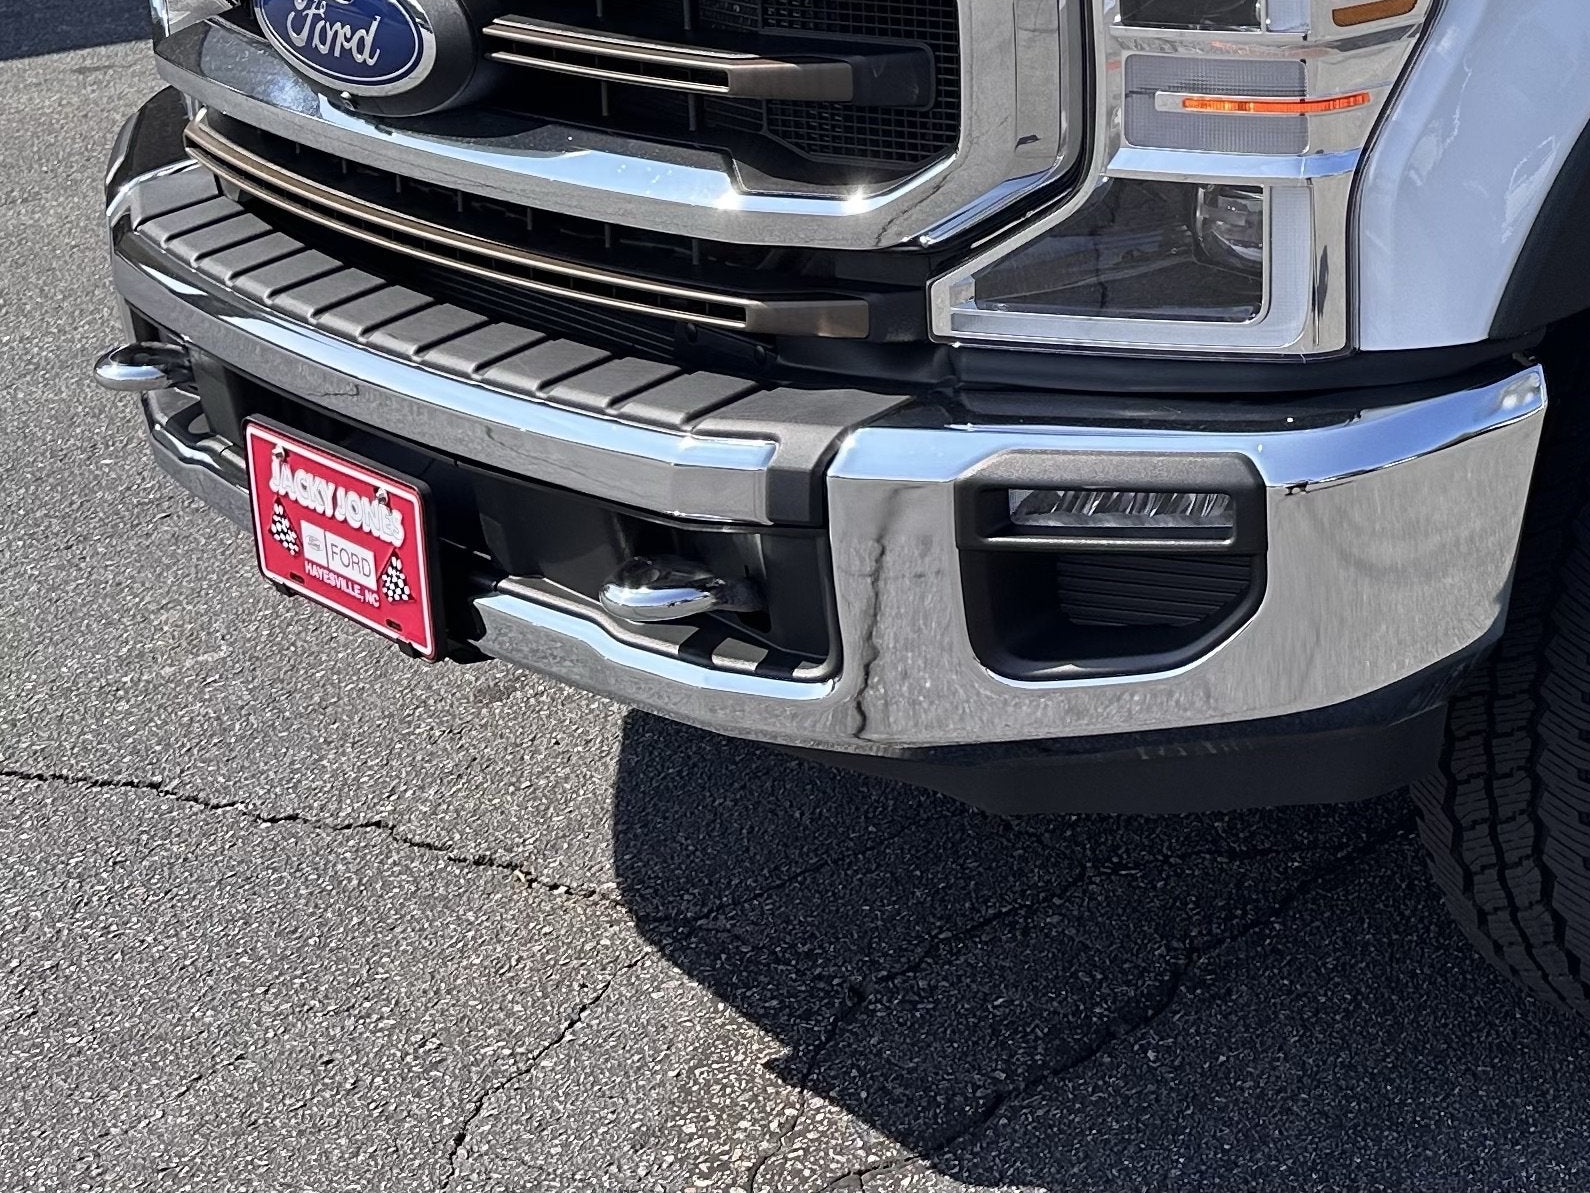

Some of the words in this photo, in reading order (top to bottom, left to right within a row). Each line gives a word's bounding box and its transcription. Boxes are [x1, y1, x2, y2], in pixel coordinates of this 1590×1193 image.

[268, 460, 336, 518] JACKY
[334, 484, 406, 548] JONES
[330, 541, 372, 578] FORD
[304, 560, 364, 604] HAYESVILLE,
[364, 589, 380, 608] NC
